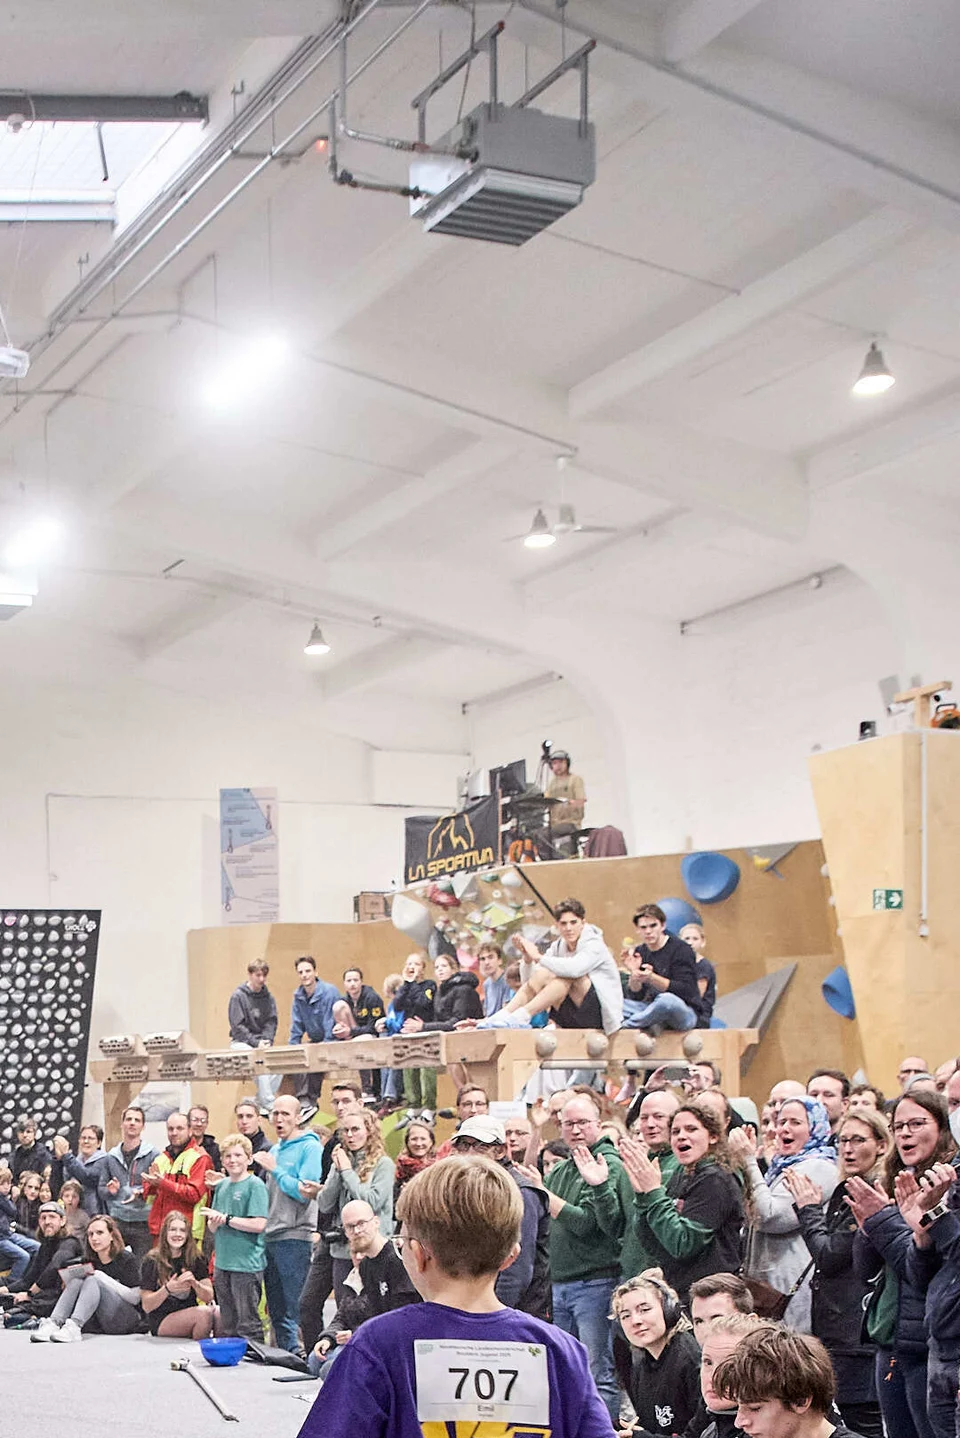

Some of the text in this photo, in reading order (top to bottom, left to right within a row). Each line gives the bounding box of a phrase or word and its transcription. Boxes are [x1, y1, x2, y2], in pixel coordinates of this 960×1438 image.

[408, 847, 495, 881] LA SPORTIVA
[448, 1367, 519, 1401] 707
